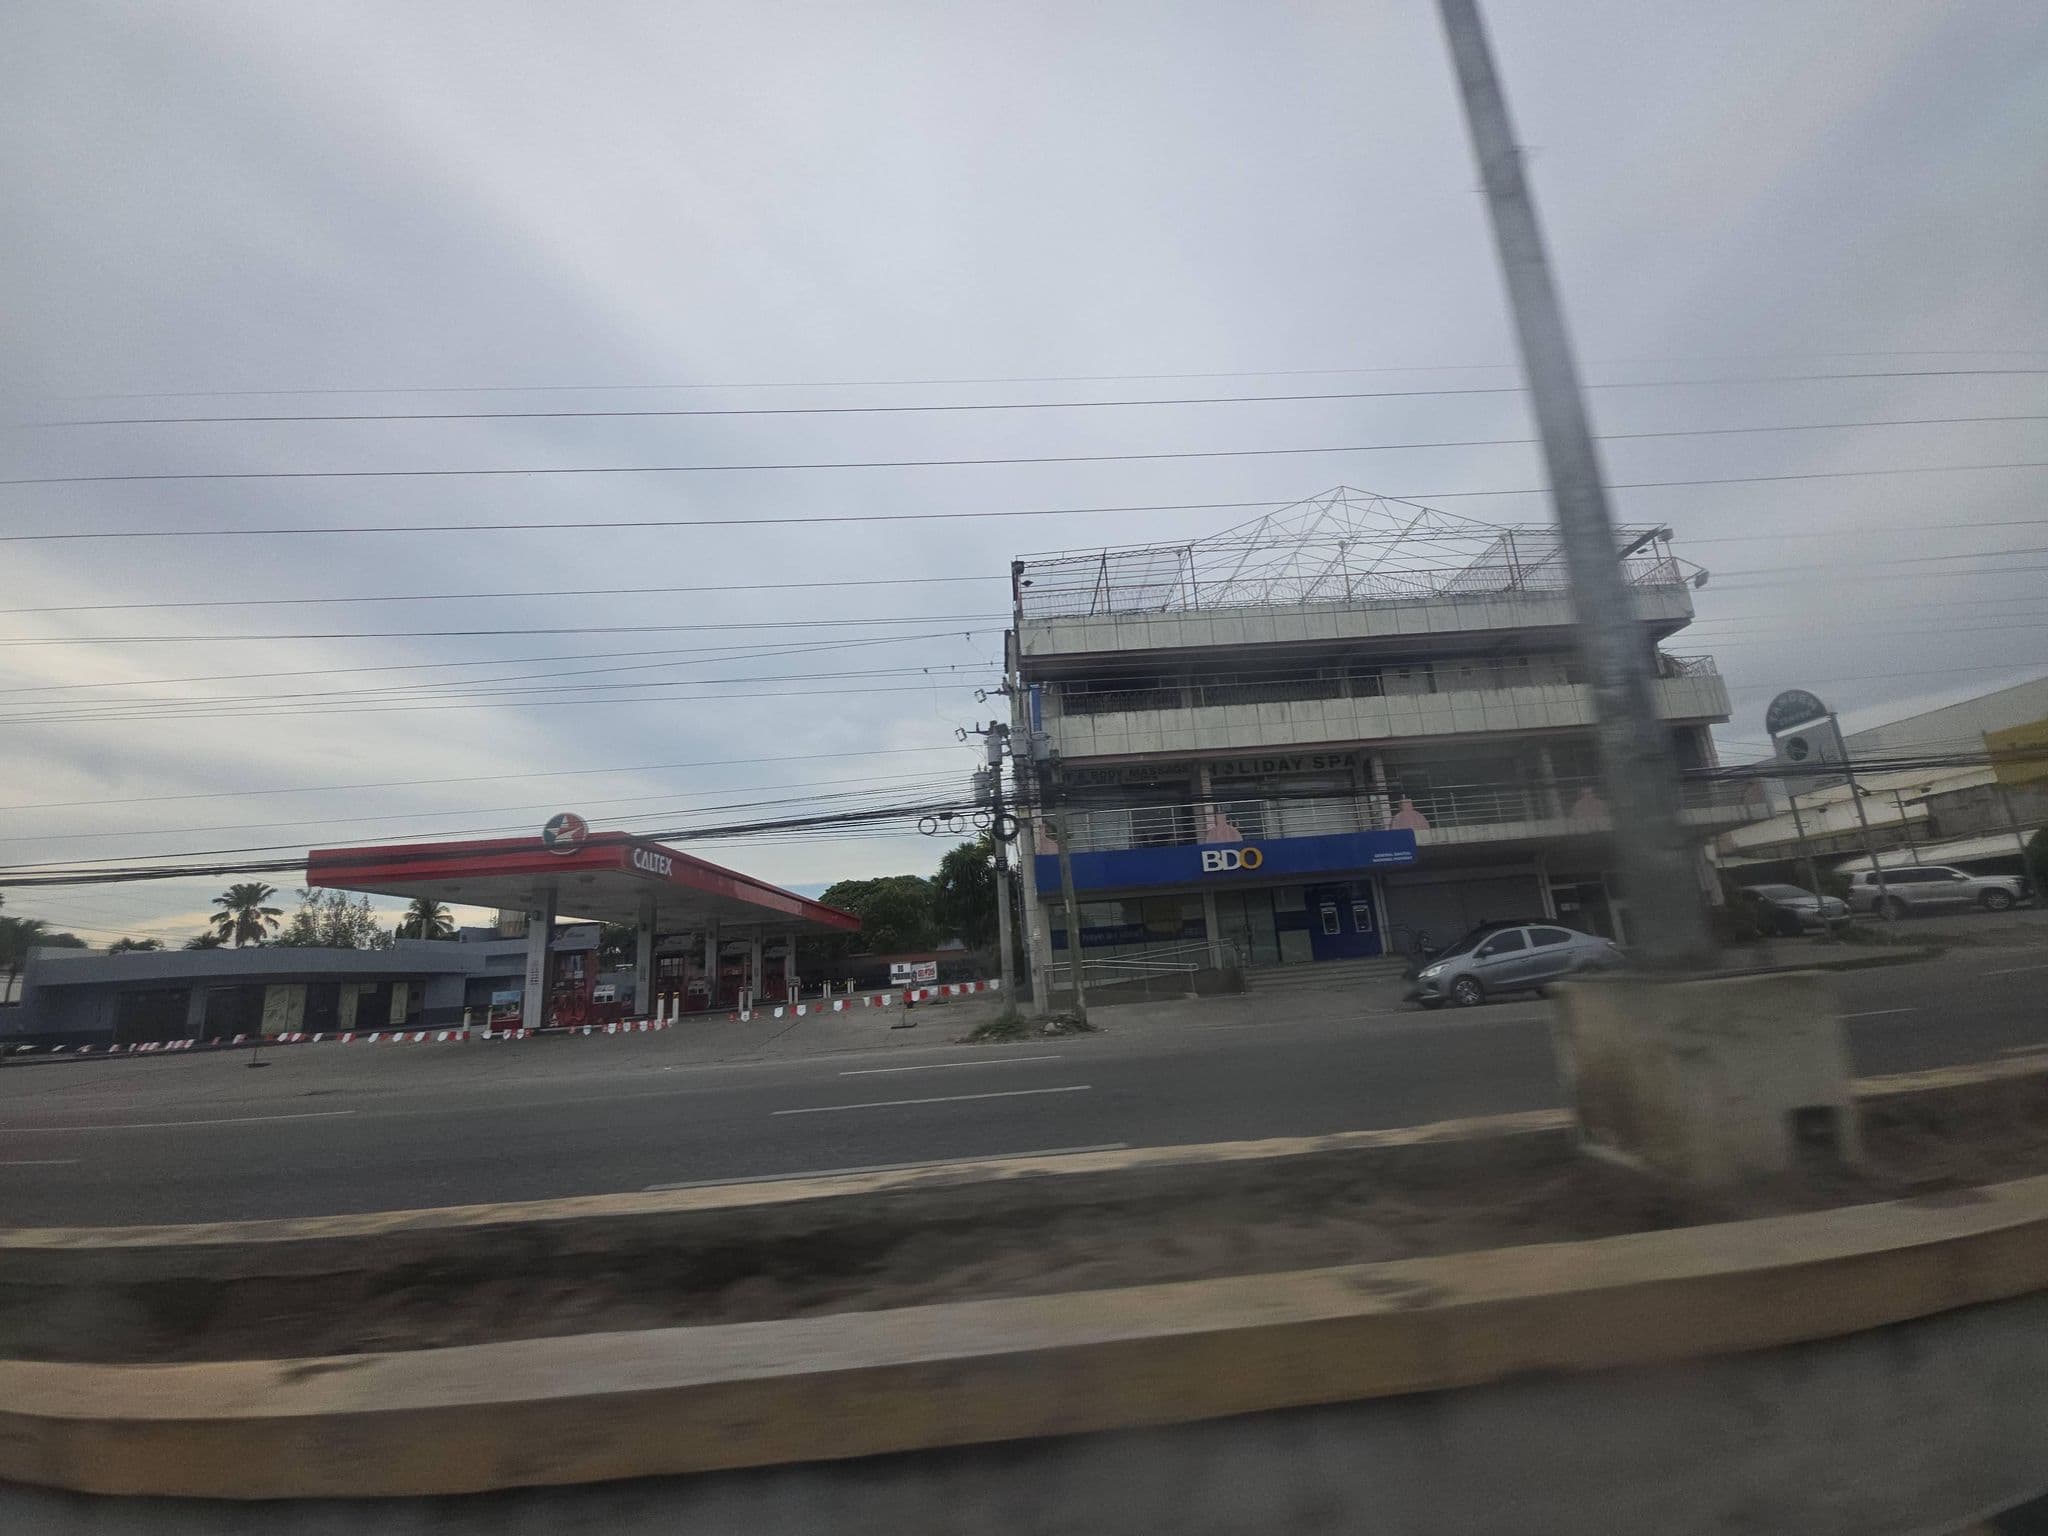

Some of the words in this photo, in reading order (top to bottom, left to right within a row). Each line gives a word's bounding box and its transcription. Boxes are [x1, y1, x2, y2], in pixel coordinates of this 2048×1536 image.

[1312, 754, 1355, 770] SPA
[633, 848, 673, 876] CALTEX
[1201, 847, 1264, 873] BDO
